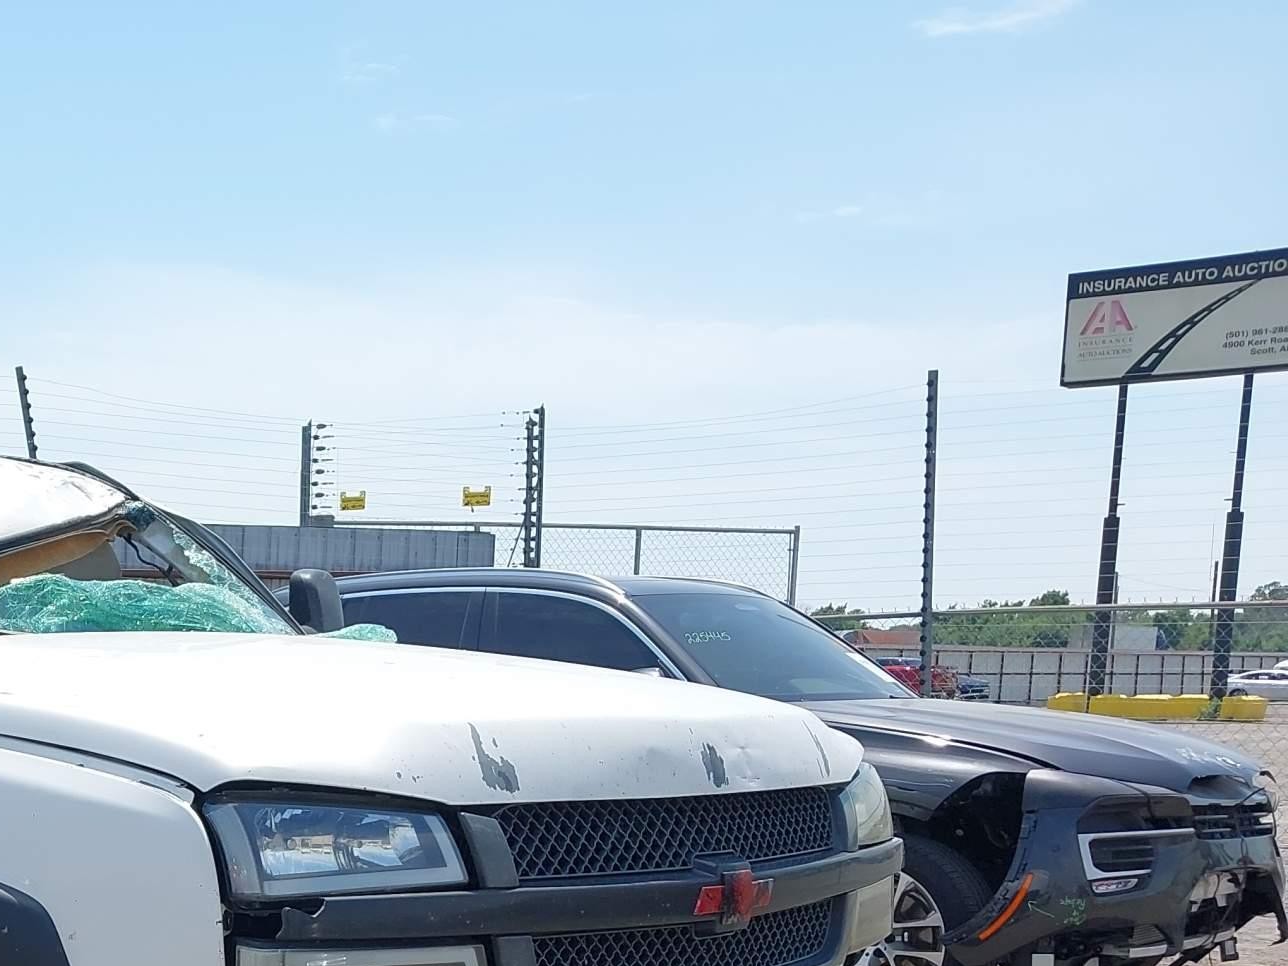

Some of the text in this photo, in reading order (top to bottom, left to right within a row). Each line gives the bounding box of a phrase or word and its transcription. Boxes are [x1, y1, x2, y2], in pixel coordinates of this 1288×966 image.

[1078, 258, 1288, 295] INSURANCE AUTO AUCTIO
[1225, 330, 1249, 340] (501)
[1222, 340, 1245, 349] 4900
[1248, 339, 1268, 347] Kerr
[684, 630, 731, 645] 225445
